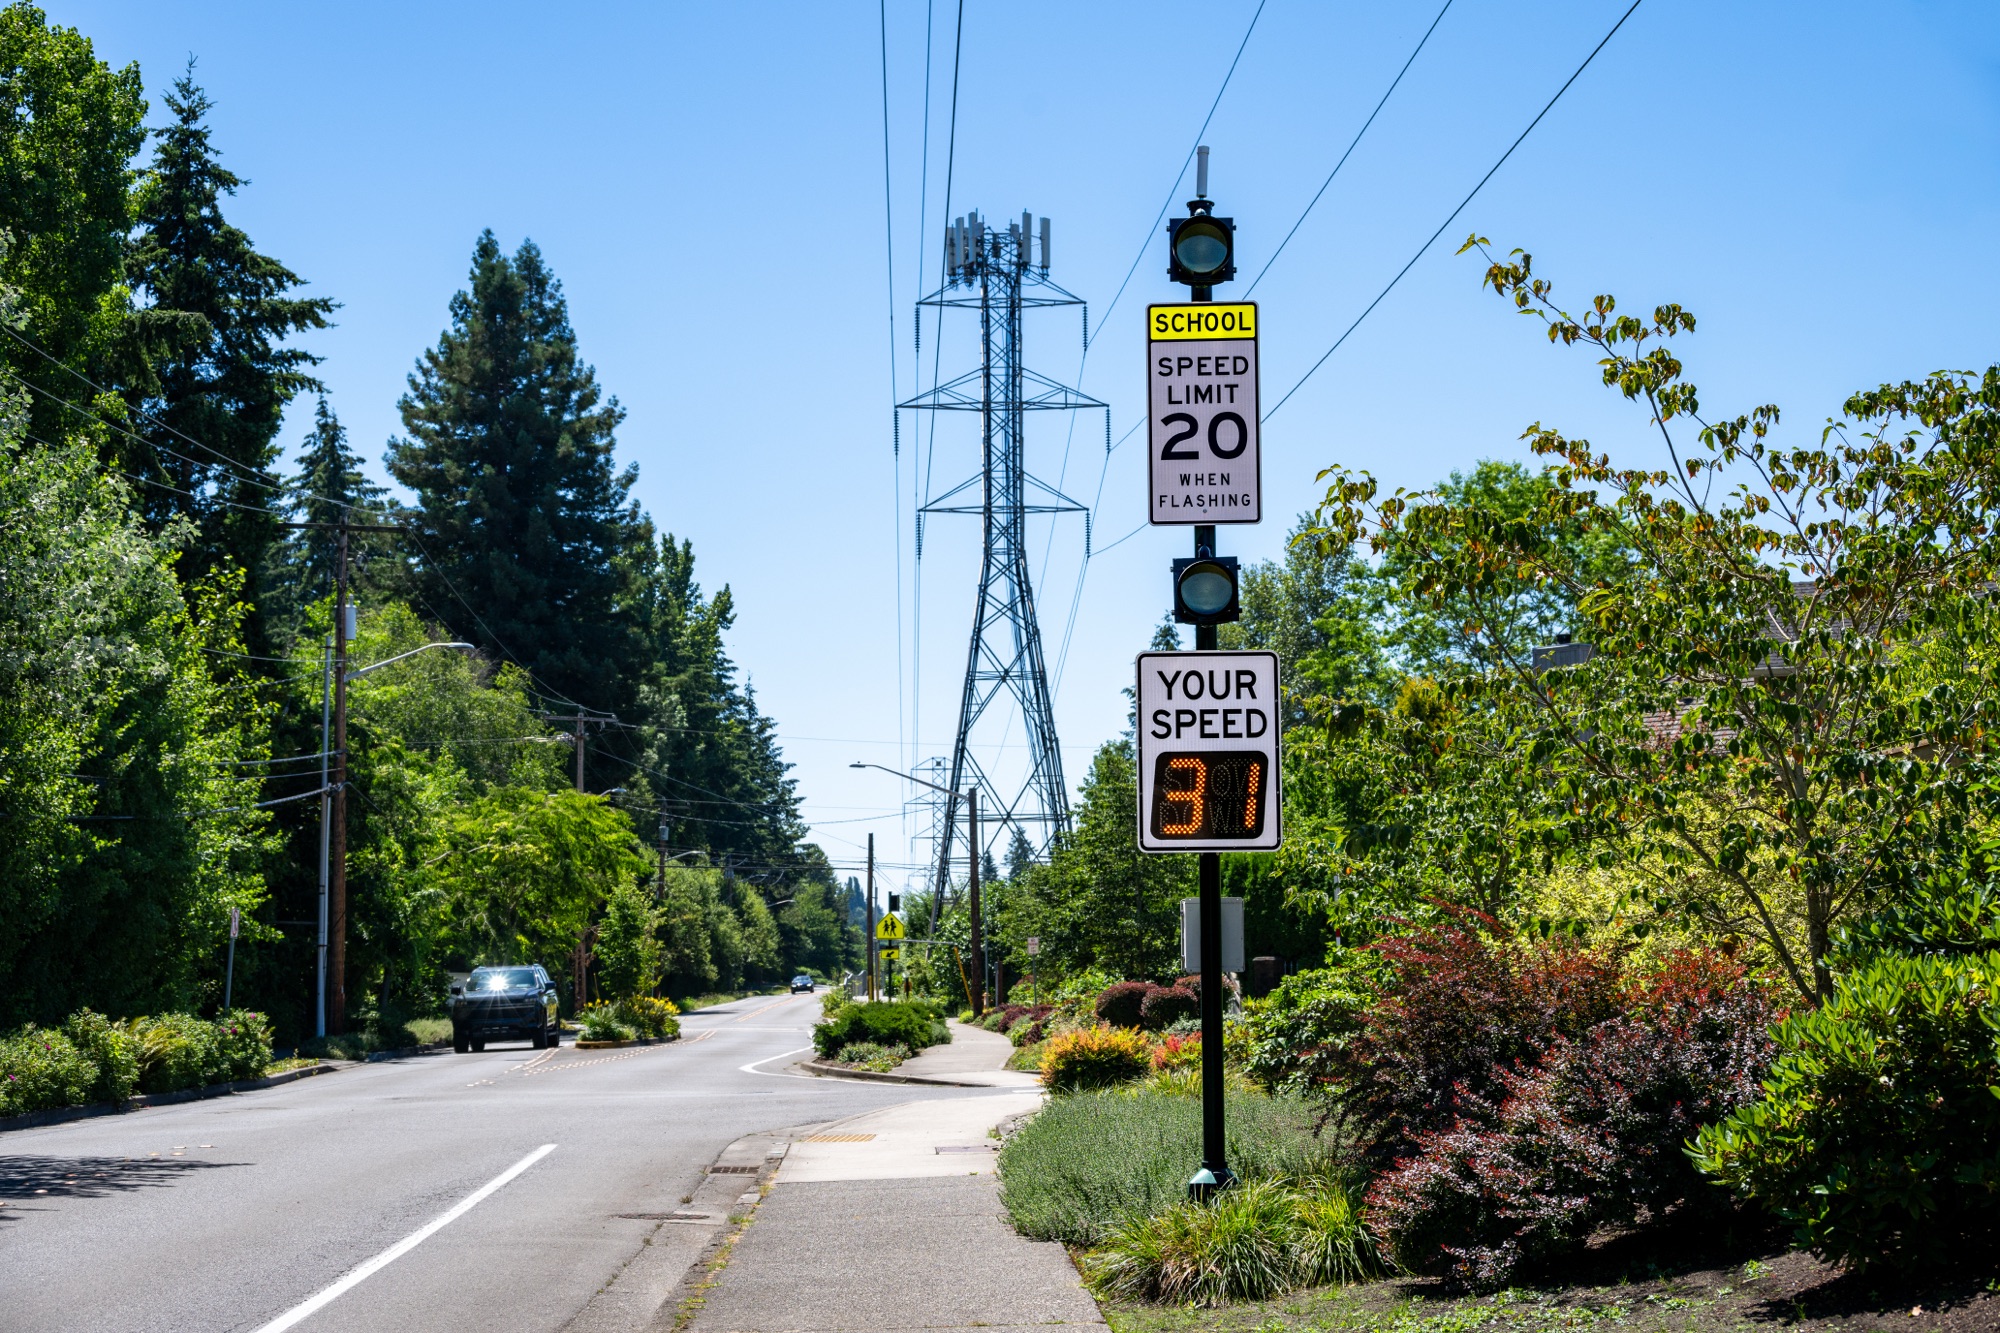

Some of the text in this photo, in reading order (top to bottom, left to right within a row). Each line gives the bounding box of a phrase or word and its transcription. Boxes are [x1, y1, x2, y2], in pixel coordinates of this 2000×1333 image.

[1155, 311, 1252, 333] SCHOOL
[1158, 356, 1249, 377] SPEED
[1168, 384, 1239, 405] LIMIT
[1160, 411, 1248, 461] 20
[1179, 473, 1231, 486] WHEN
[1159, 494, 1251, 508] FLASHING
[1156, 670, 1258, 700] YOUR
[1150, 708, 1268, 739] SPEED
[1163, 758, 1261, 834] 31
